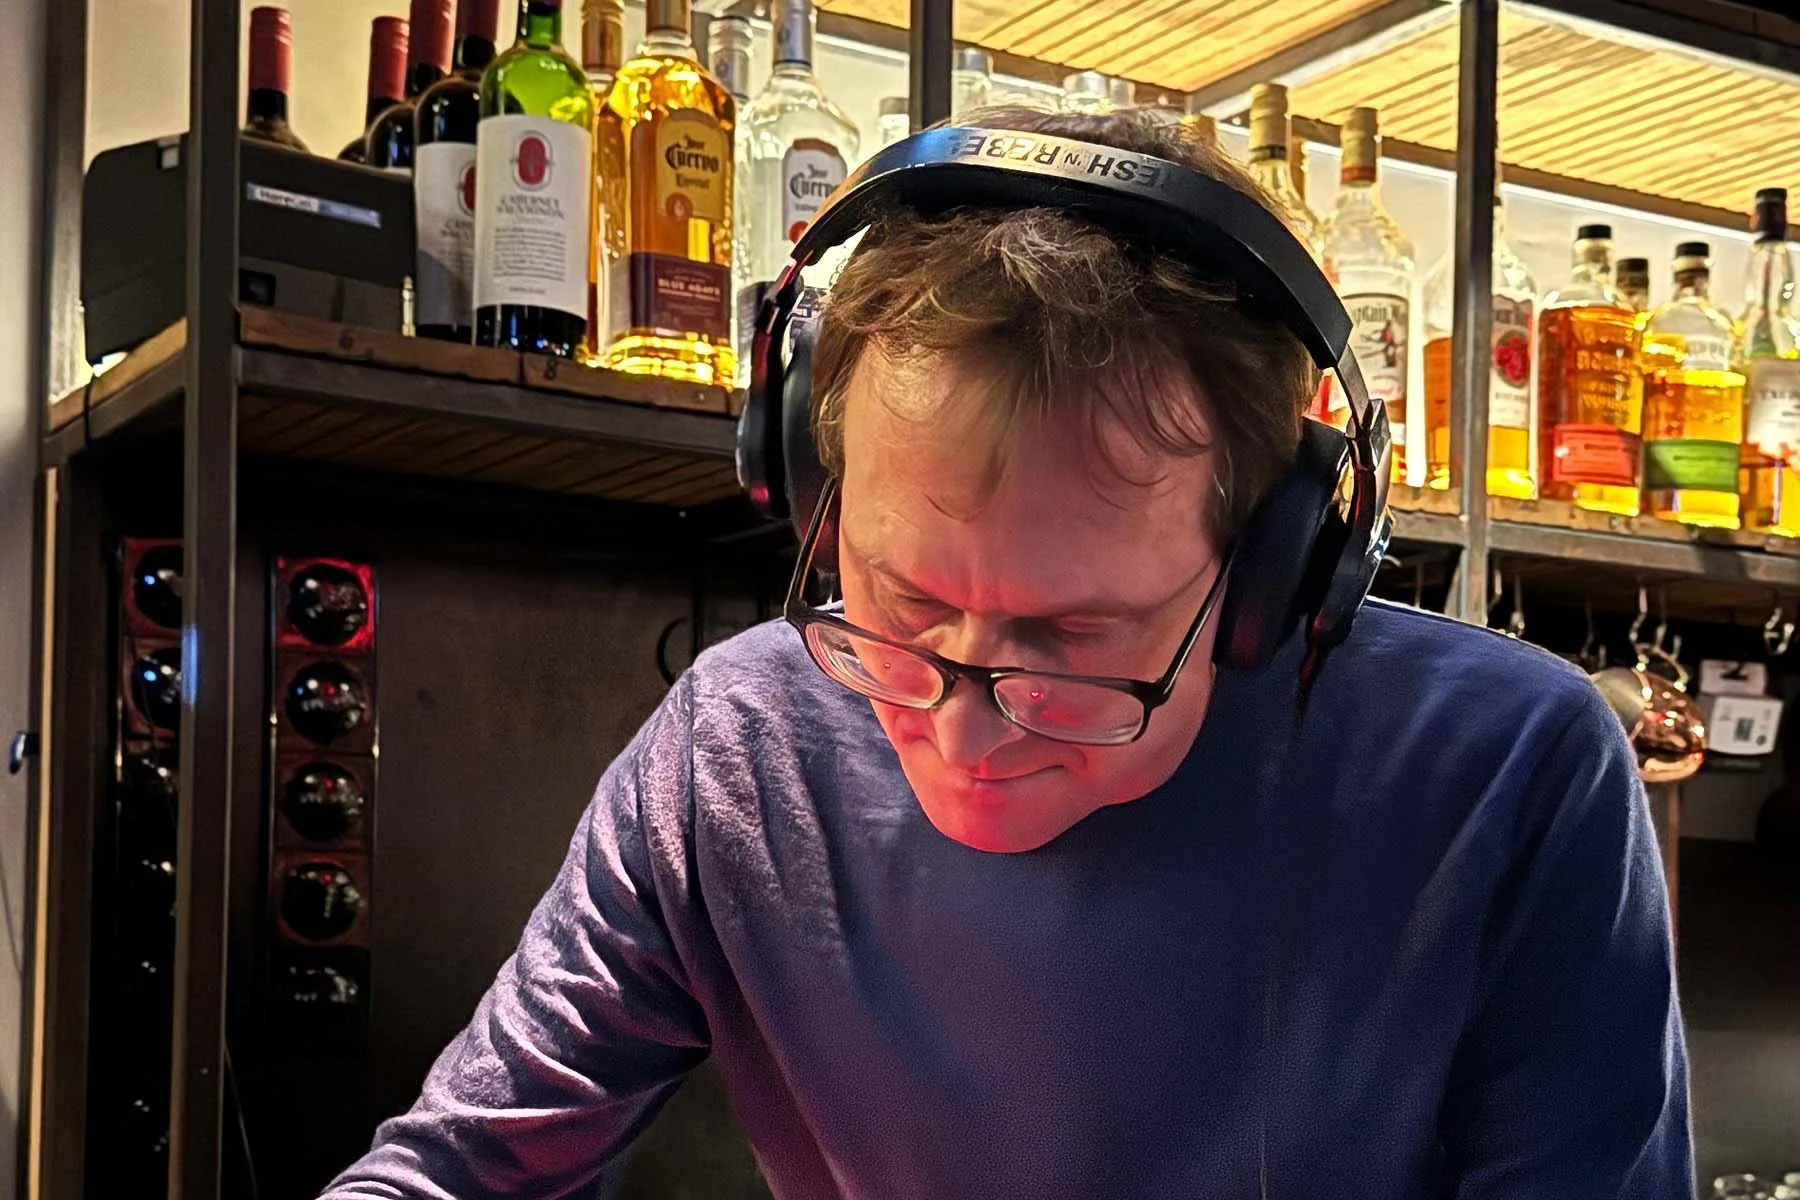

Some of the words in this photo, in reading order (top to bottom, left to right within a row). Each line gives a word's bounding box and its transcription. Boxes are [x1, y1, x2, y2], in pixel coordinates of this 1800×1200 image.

[664, 142, 719, 173] Cuervo
[789, 171, 835, 200] Cuerv
[658, 278, 685, 291] BLUE
